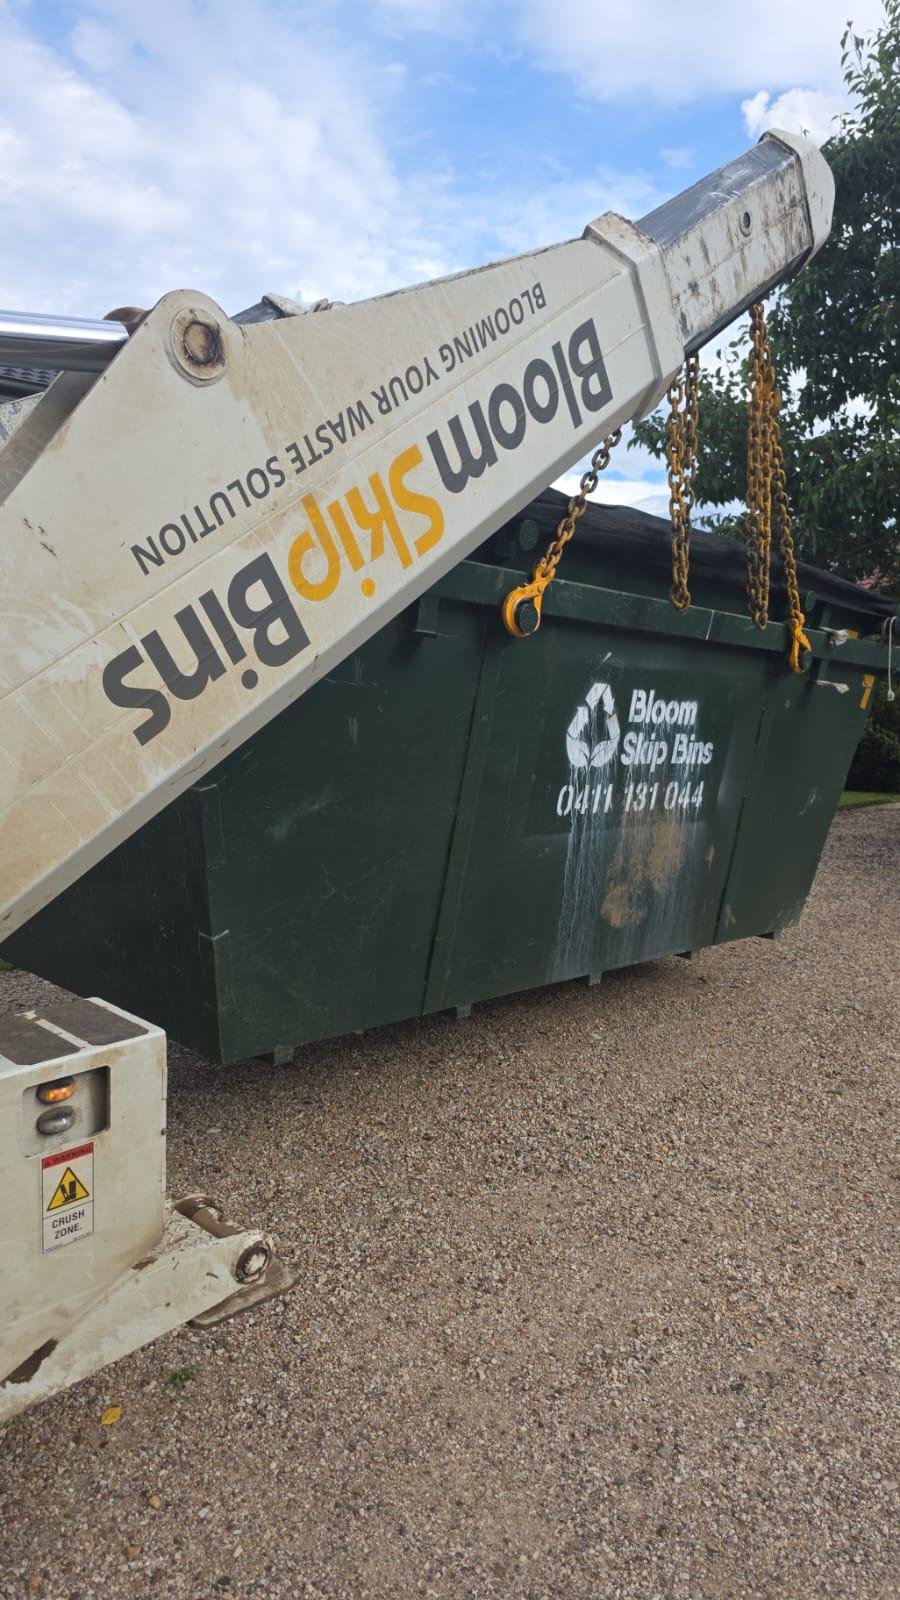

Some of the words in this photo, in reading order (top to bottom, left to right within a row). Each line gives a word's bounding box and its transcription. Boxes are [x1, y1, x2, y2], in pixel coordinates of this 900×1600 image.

[438, 282, 547, 373] BLOOMING
[370, 357, 440, 415] YOUR
[426, 317, 614, 493] Bloom
[285, 400, 375, 474] WASTE
[130, 455, 286, 576] SOLUTION
[287, 443, 445, 602] Skip
[102, 552, 311, 746] Bins
[628, 689, 698, 725] Bloom
[621, 732, 668, 772] Skip
[671, 733, 714, 765] Bins
[556, 784, 613, 816] 0411
[624, 782, 659, 812] 131
[664, 781, 704, 809] 044
[52, 1209, 85, 1229] CRUSH
[54, 1223, 82, 1240] ZONE.
